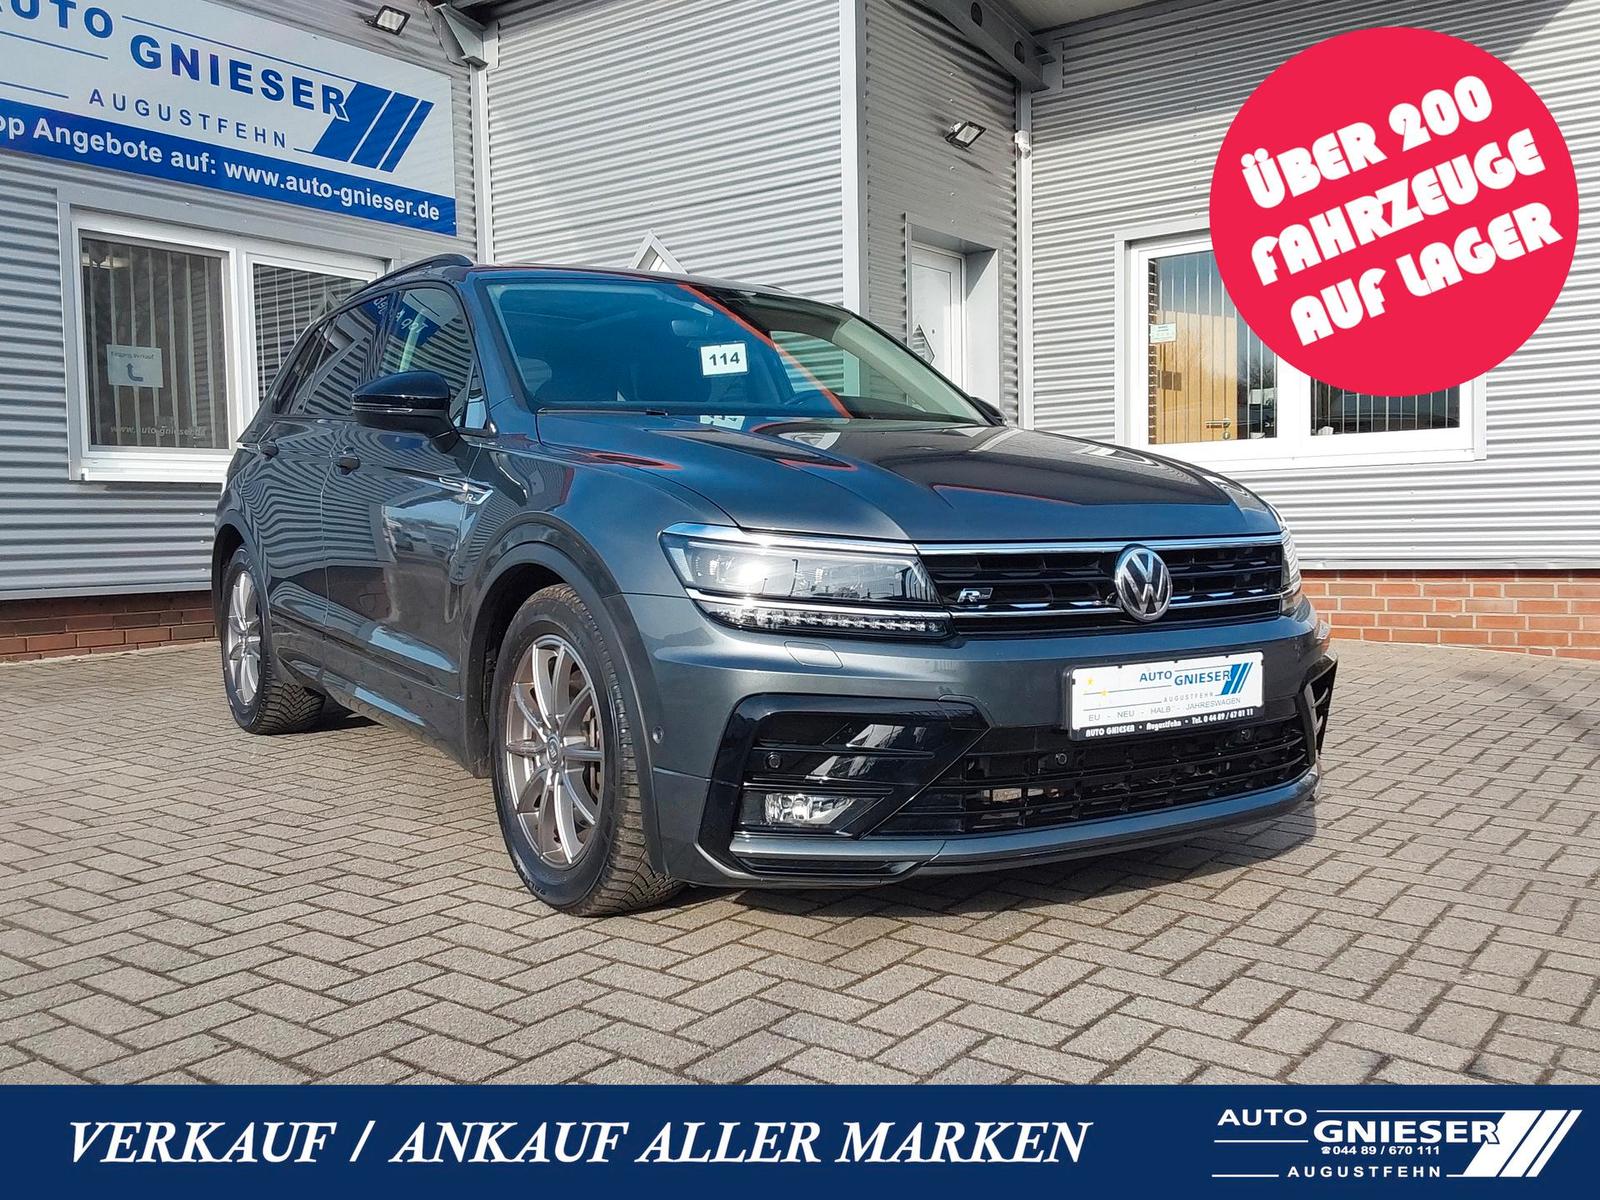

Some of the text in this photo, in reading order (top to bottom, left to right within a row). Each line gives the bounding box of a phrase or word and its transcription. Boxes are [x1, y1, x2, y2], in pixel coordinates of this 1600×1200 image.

[0, 0, 349, 121] UTO GNIESER
[89, 89, 286, 148] AUGUSTFEHN
[33, 117, 163, 164] Angebote
[170, 151, 217, 175] auf:
[223, 161, 440, 221] www.auto-gnieser.de
[709, 351, 740, 366] 114
[1139, 670, 1232, 686] AUTO GNIESER
[1163, 692, 1214, 703] AUGUSTFEHN
[1088, 713, 1101, 722] EU
[1117, 709, 1135, 719] NEU
[1150, 705, 1171, 715] HALB
[1186, 697, 1241, 711] JAHRESWAGEN
[1085, 728, 1105, 737] AUTO
